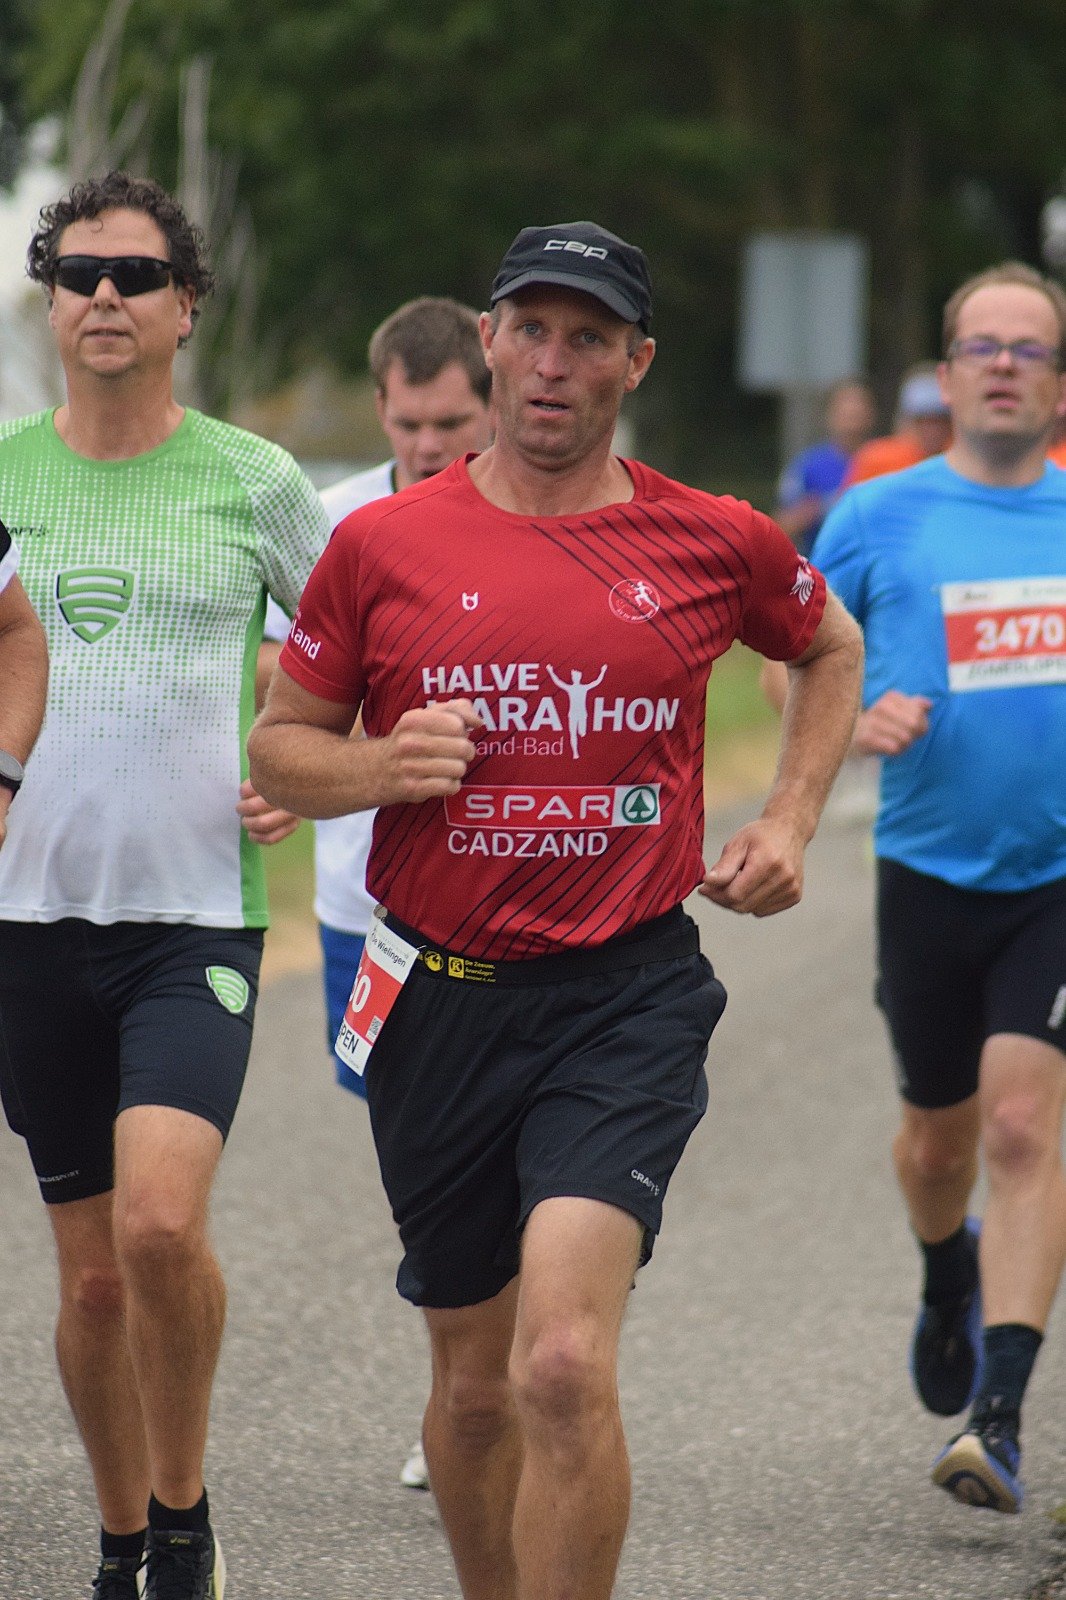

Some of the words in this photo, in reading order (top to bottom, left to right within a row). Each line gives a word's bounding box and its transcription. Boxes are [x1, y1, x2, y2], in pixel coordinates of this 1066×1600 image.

[974, 613, 1064, 652] 3470
[422, 663, 540, 694] HALVE
[426, 696, 680, 732] ARATHON
[474, 736, 563, 756] and-Bad
[465, 794, 611, 820] SPAR
[447, 830, 608, 857] CADZAND
[378, 940, 407, 968] Wielingen
[348, 968, 371, 1013] 0
[339, 1022, 360, 1054] PEN
